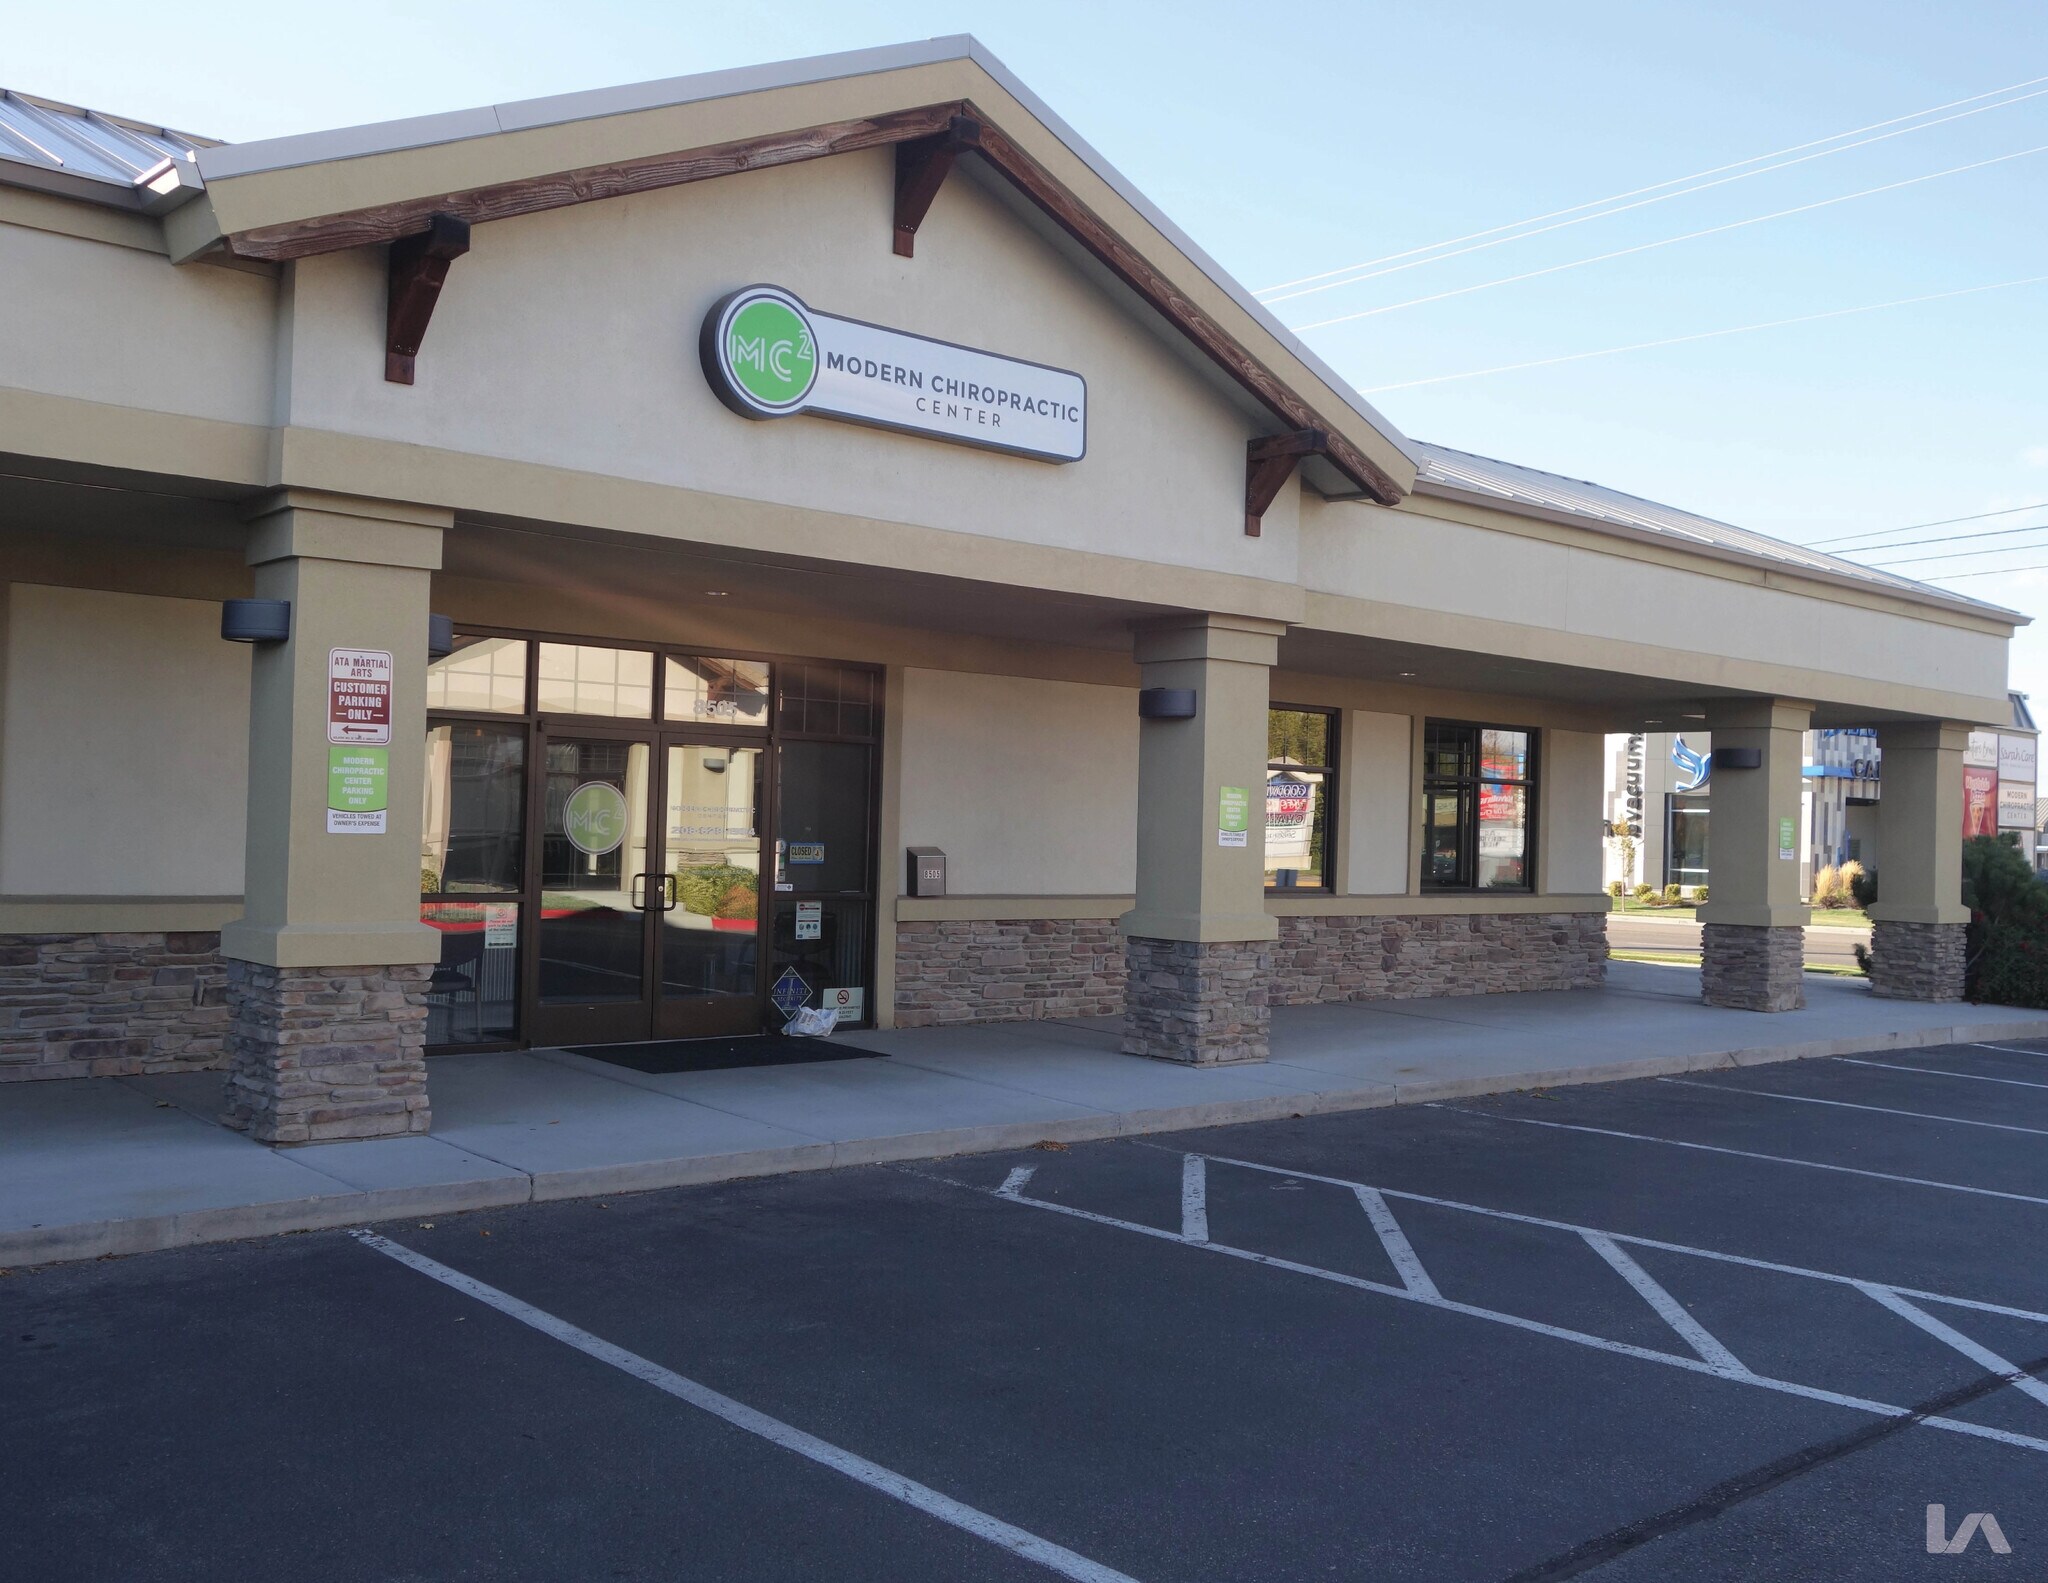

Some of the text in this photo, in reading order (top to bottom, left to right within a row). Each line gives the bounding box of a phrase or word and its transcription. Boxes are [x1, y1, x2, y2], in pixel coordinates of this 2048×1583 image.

[827, 351, 1080, 424] MODERN CHIROPRACTIC
[915, 397, 1002, 428] CENTER
[334, 657, 388, 669] ATA MARTIAL
[351, 668, 373, 678] ARTS
[334, 682, 387, 695] CUSTOMER
[338, 695, 382, 708] PARKING
[693, 699, 738, 716] 8505
[347, 709, 373, 720] ONLY
[343, 757, 375, 765] MODERN
[332, 767, 385, 775] CHIROPRACTIC
[344, 777, 372, 785] CENTER
[342, 787, 374, 795] PARKING
[2007, 791, 2028, 800] MODERN
[2000, 802, 2034, 811] CHIROPRACTIC
[791, 846, 812, 856] CLOSED
[924, 870, 940, 879] 8505
